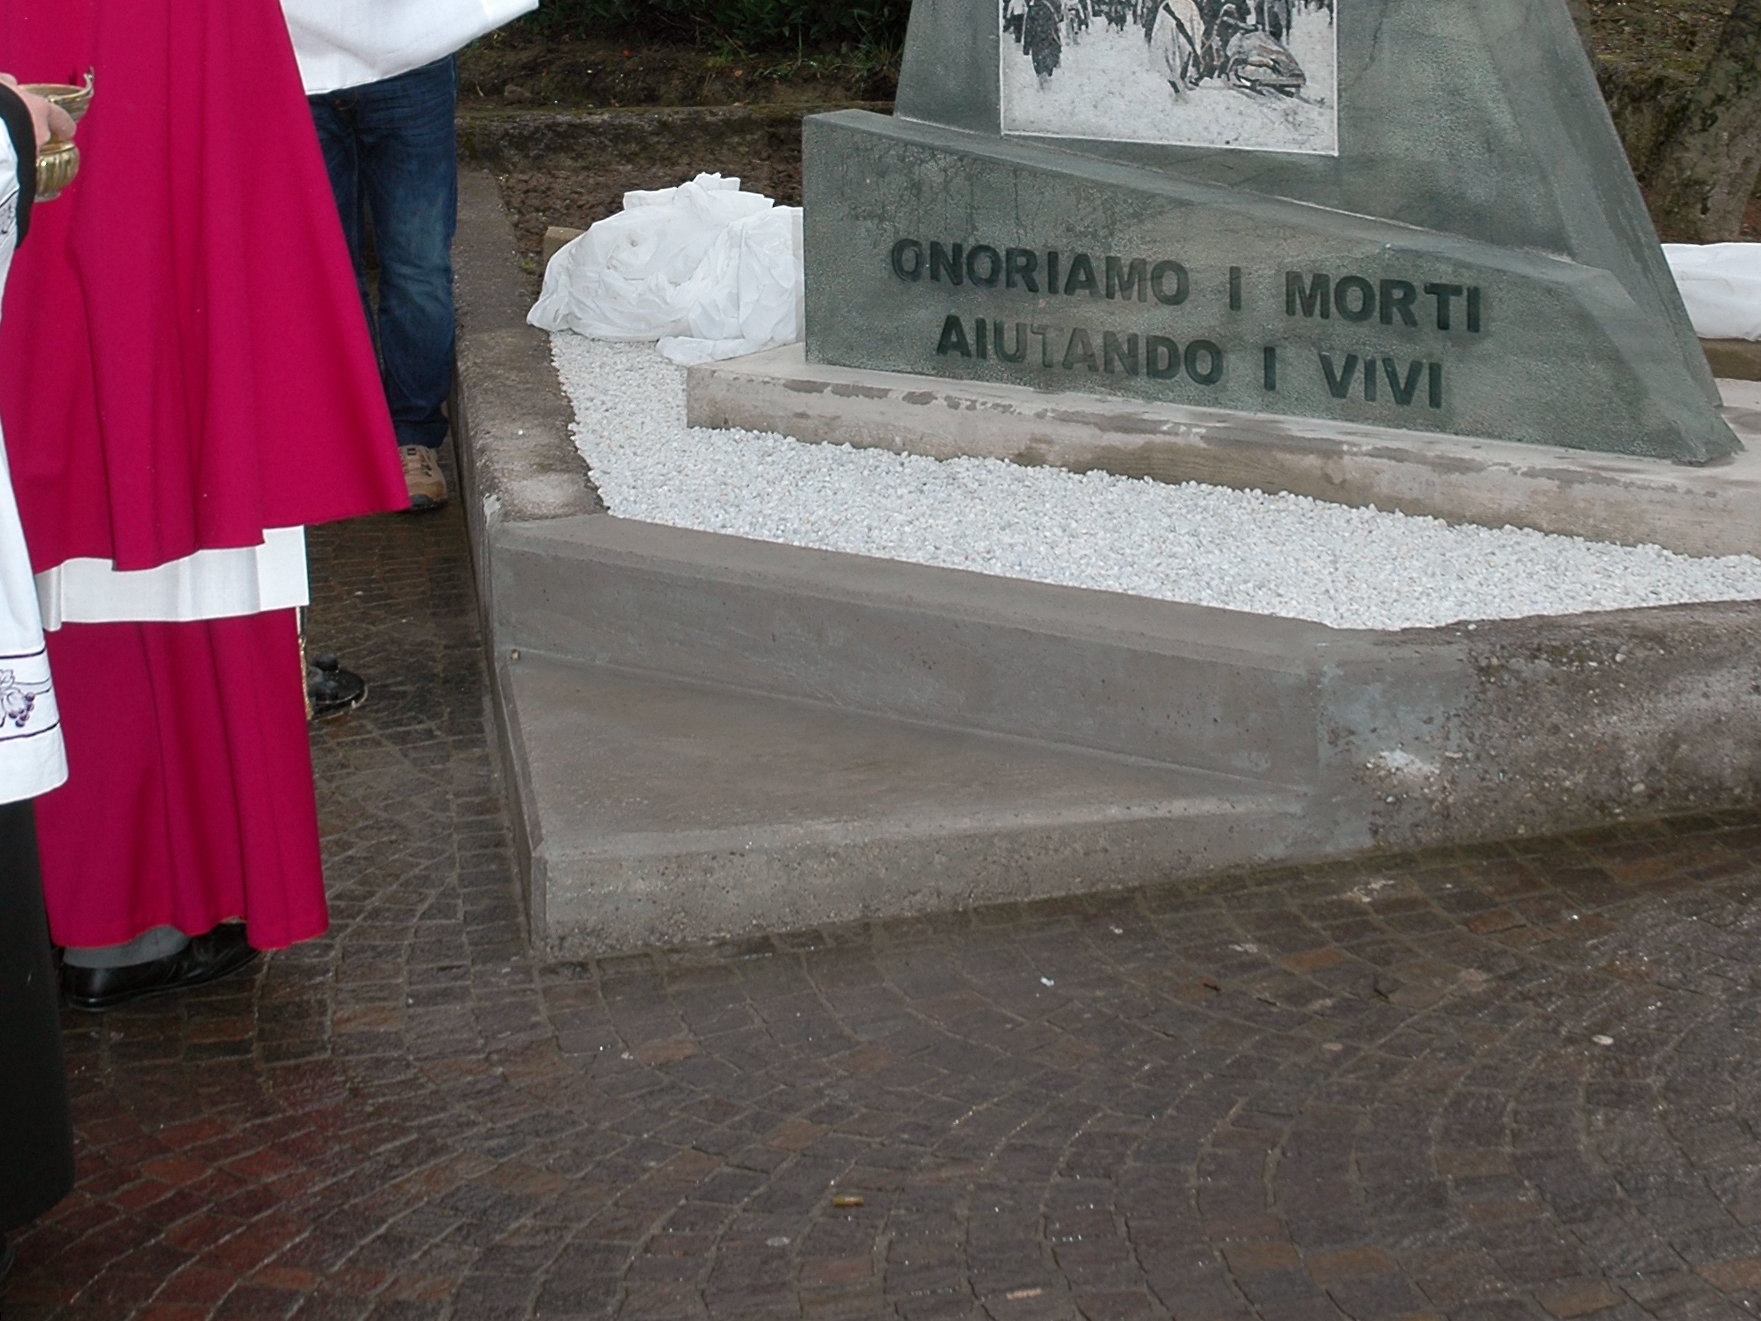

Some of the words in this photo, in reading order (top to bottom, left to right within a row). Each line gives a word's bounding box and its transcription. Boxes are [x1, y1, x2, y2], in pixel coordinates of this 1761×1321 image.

[891, 237, 1190, 307] ONORIAMO
[1229, 265, 1243, 312] I
[1284, 270, 1481, 334] MORTI
[936, 314, 1224, 386] AIUTANDO
[1263, 345, 1277, 392] I
[1319, 351, 1443, 409] VIVI
